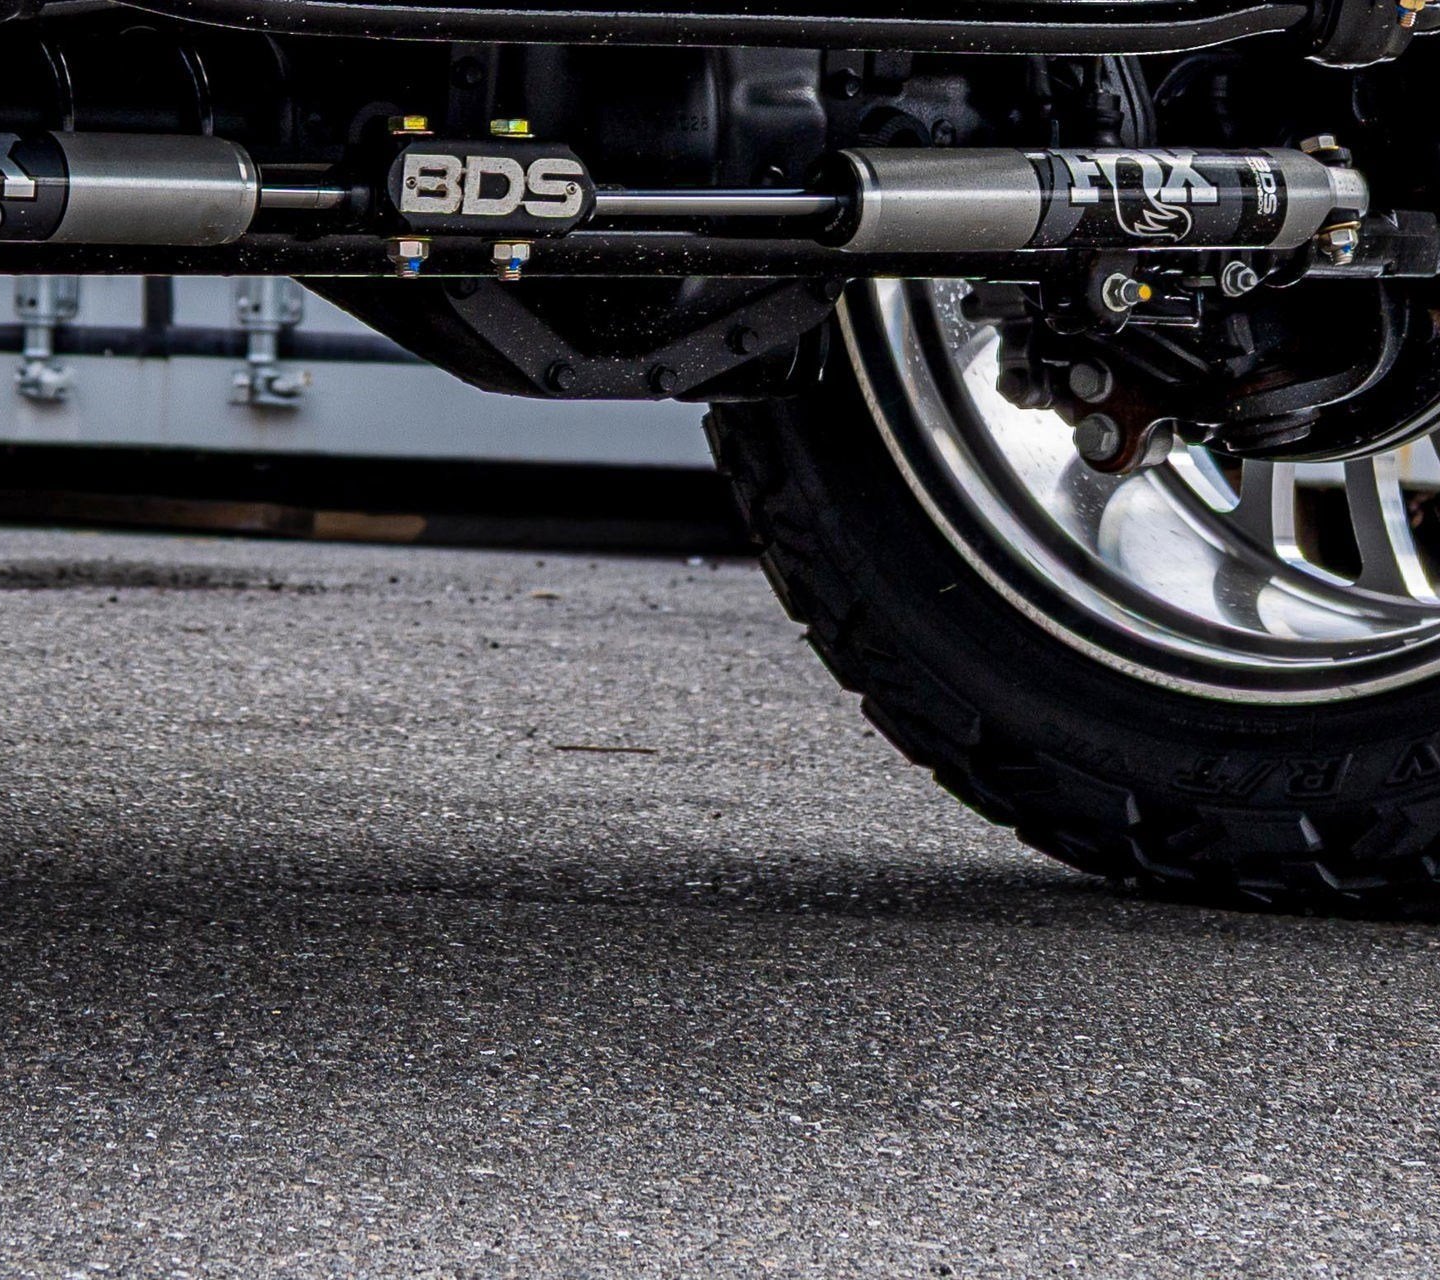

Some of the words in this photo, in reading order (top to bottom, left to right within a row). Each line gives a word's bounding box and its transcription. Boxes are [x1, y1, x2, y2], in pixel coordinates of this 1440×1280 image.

[400, 153, 583, 218] BDS
[1048, 148, 1217, 241] FOX
[1251, 156, 1277, 215] BDS
